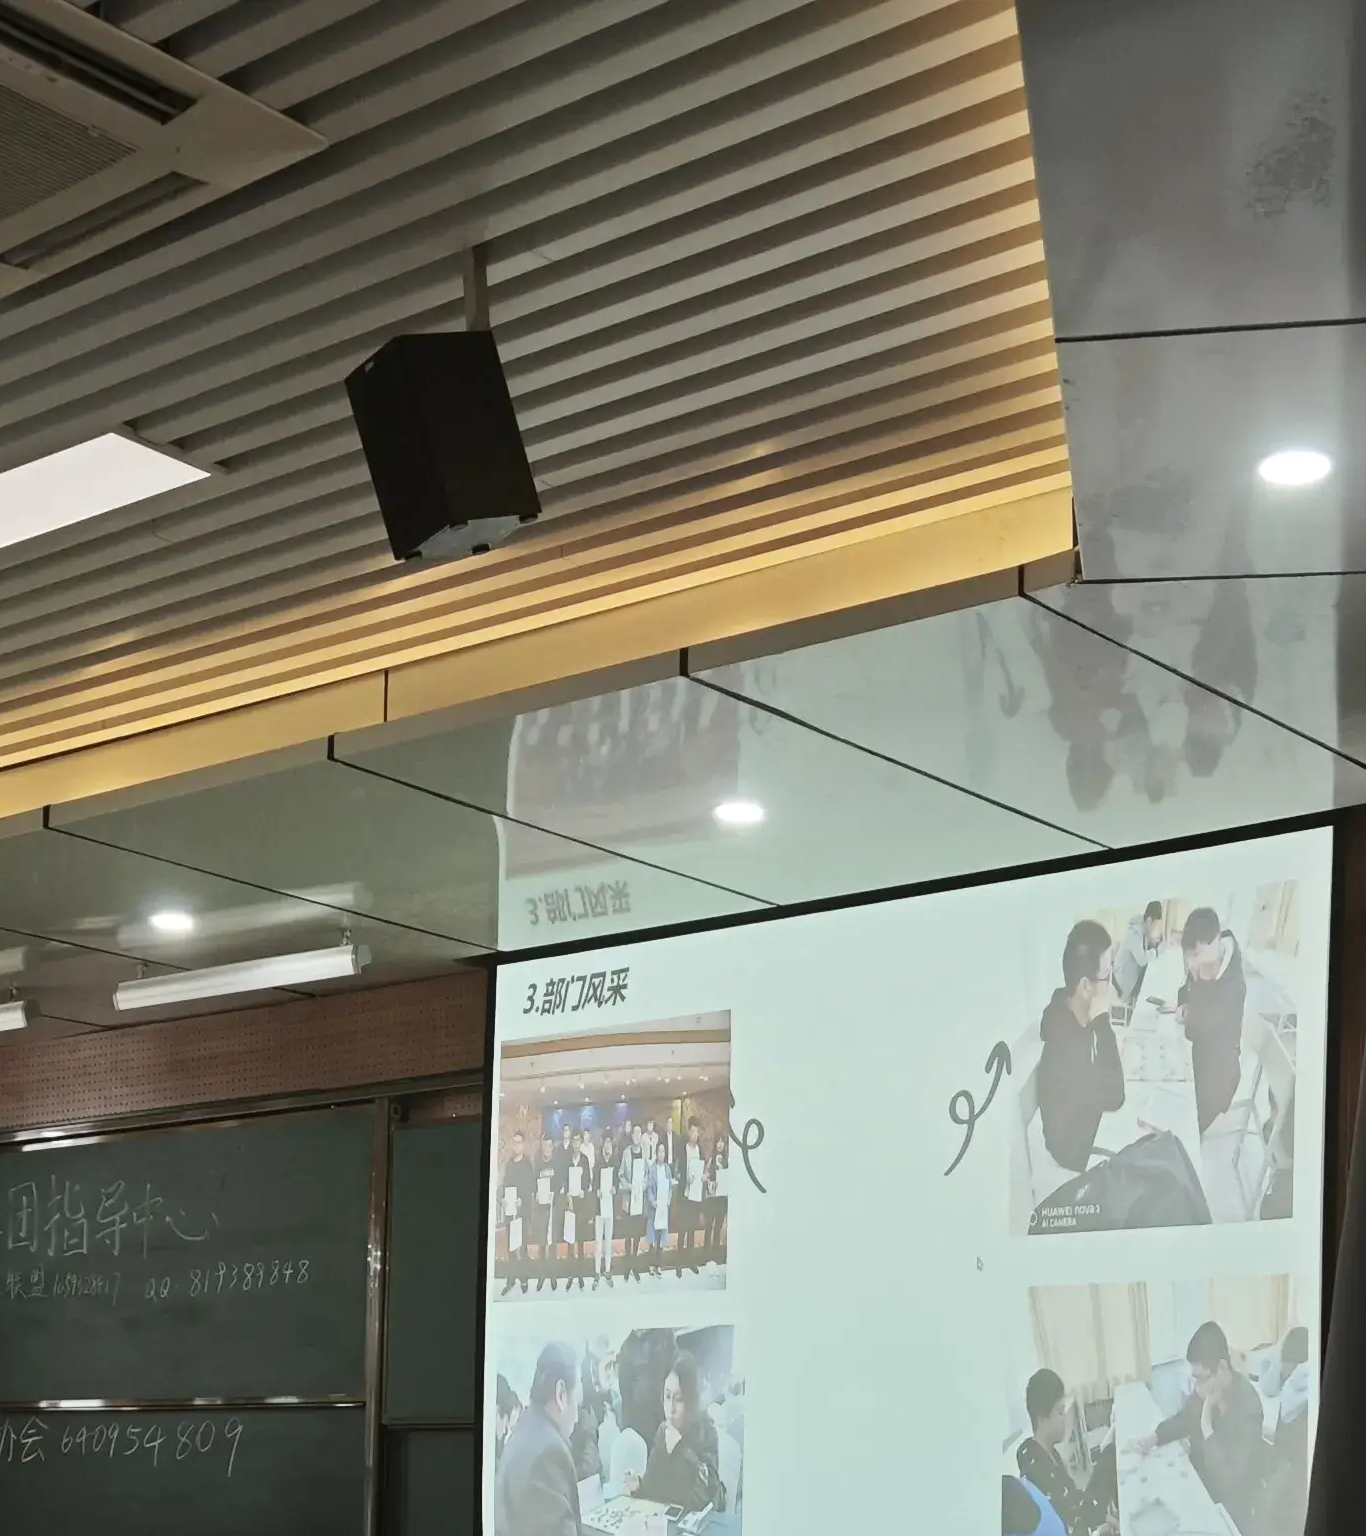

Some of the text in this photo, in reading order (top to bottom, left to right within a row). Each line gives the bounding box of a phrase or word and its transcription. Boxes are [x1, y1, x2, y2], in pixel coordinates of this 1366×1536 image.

[522, 966, 630, 1016] 3.部门风采
[1041, 1205, 1073, 1217] HUAWEI
